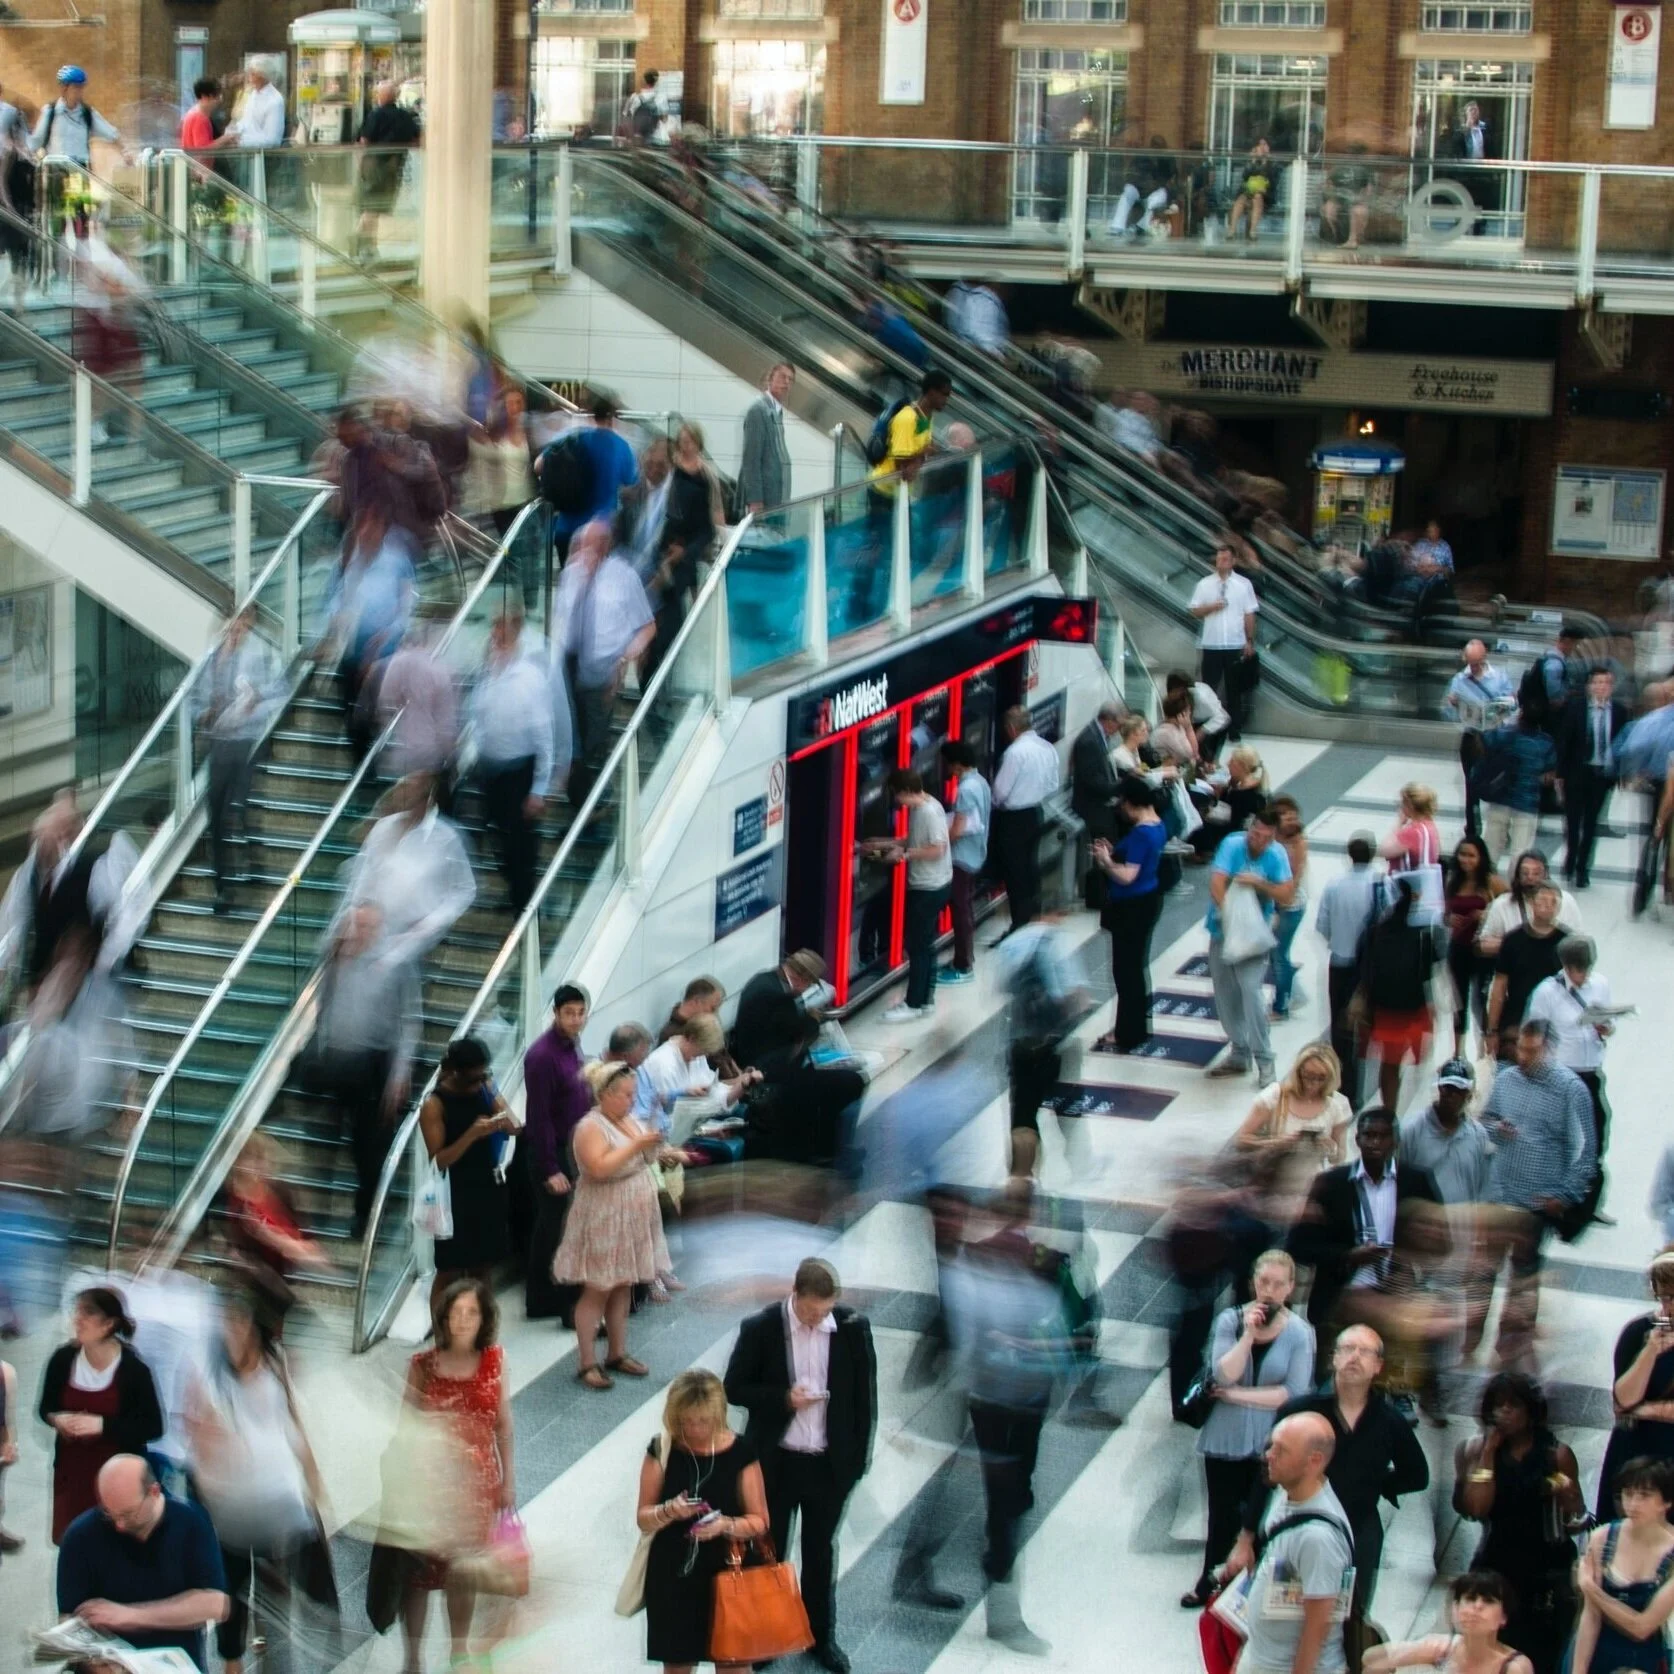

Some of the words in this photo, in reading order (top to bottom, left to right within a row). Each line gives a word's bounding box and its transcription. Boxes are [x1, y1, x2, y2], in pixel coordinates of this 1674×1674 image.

[1180, 349, 1323, 379] MERCHANT
[1199, 375, 1302, 394] BISHOPSGATE
[834, 672, 889, 731] NatWest
